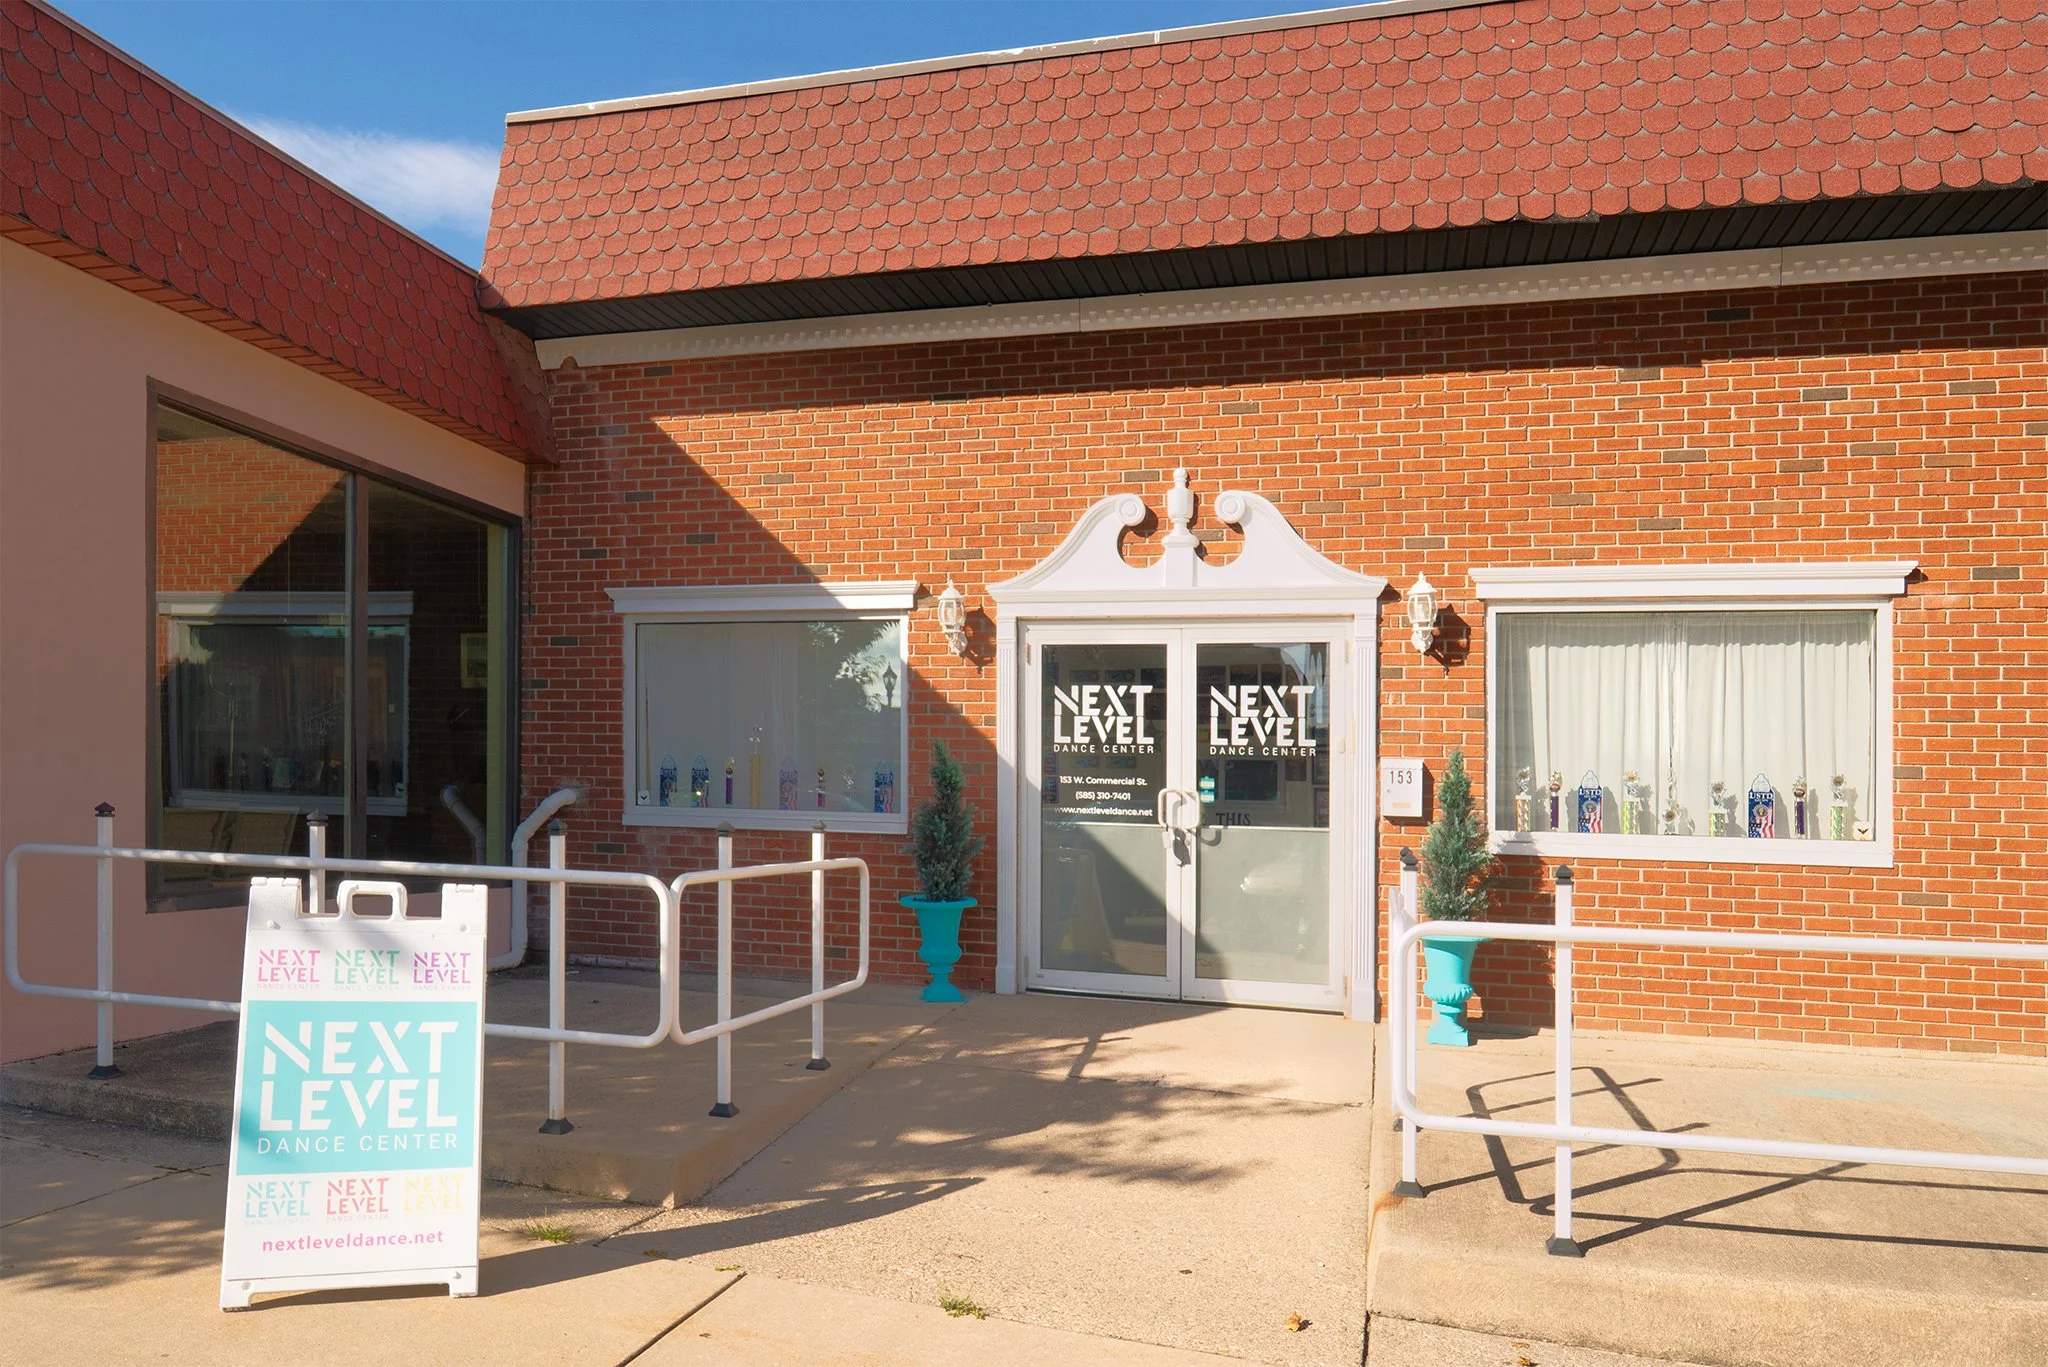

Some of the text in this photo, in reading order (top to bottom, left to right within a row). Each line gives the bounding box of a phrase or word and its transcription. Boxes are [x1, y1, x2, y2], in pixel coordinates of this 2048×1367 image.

[1054, 685, 1153, 716] NEXT
[1210, 685, 1315, 717] NEXT
[1054, 715, 1154, 744] LEVEL
[1210, 717, 1316, 747] LEVEL
[1053, 744, 1154, 754] DANCE CENTER
[1210, 746, 1316, 757] DANCE CENTER
[1059, 776, 1148, 786] 153 W. Commercial St.
[1391, 770, 1412, 784] 153
[1075, 791, 1131, 801] (585) 310-7401
[1055, 806, 1153, 817] www.nextleveldance.net
[1215, 812, 1251, 826] THIS
[259, 950, 321, 966] NEXT
[335, 950, 400, 968] NEXT
[413, 952, 471, 968] NEXT
[258, 967, 320, 983] LEVEL
[334, 968, 399, 985] LEVEL
[413, 969, 471, 984] LEVEL
[263, 1021, 459, 1075] NEXT
[259, 1078, 458, 1131] LEVEL
[257, 1133, 457, 1154] DANCE CENTER
[247, 1181, 311, 1200] NEXT
[327, 1178, 389, 1197] NEXT
[404, 1174, 464, 1193] NEXT
[245, 1200, 310, 1219] LEVEL
[326, 1197, 389, 1215] LEVEL
[403, 1194, 465, 1212] LEVEL
[262, 1230, 444, 1252] nextleveldance.net
